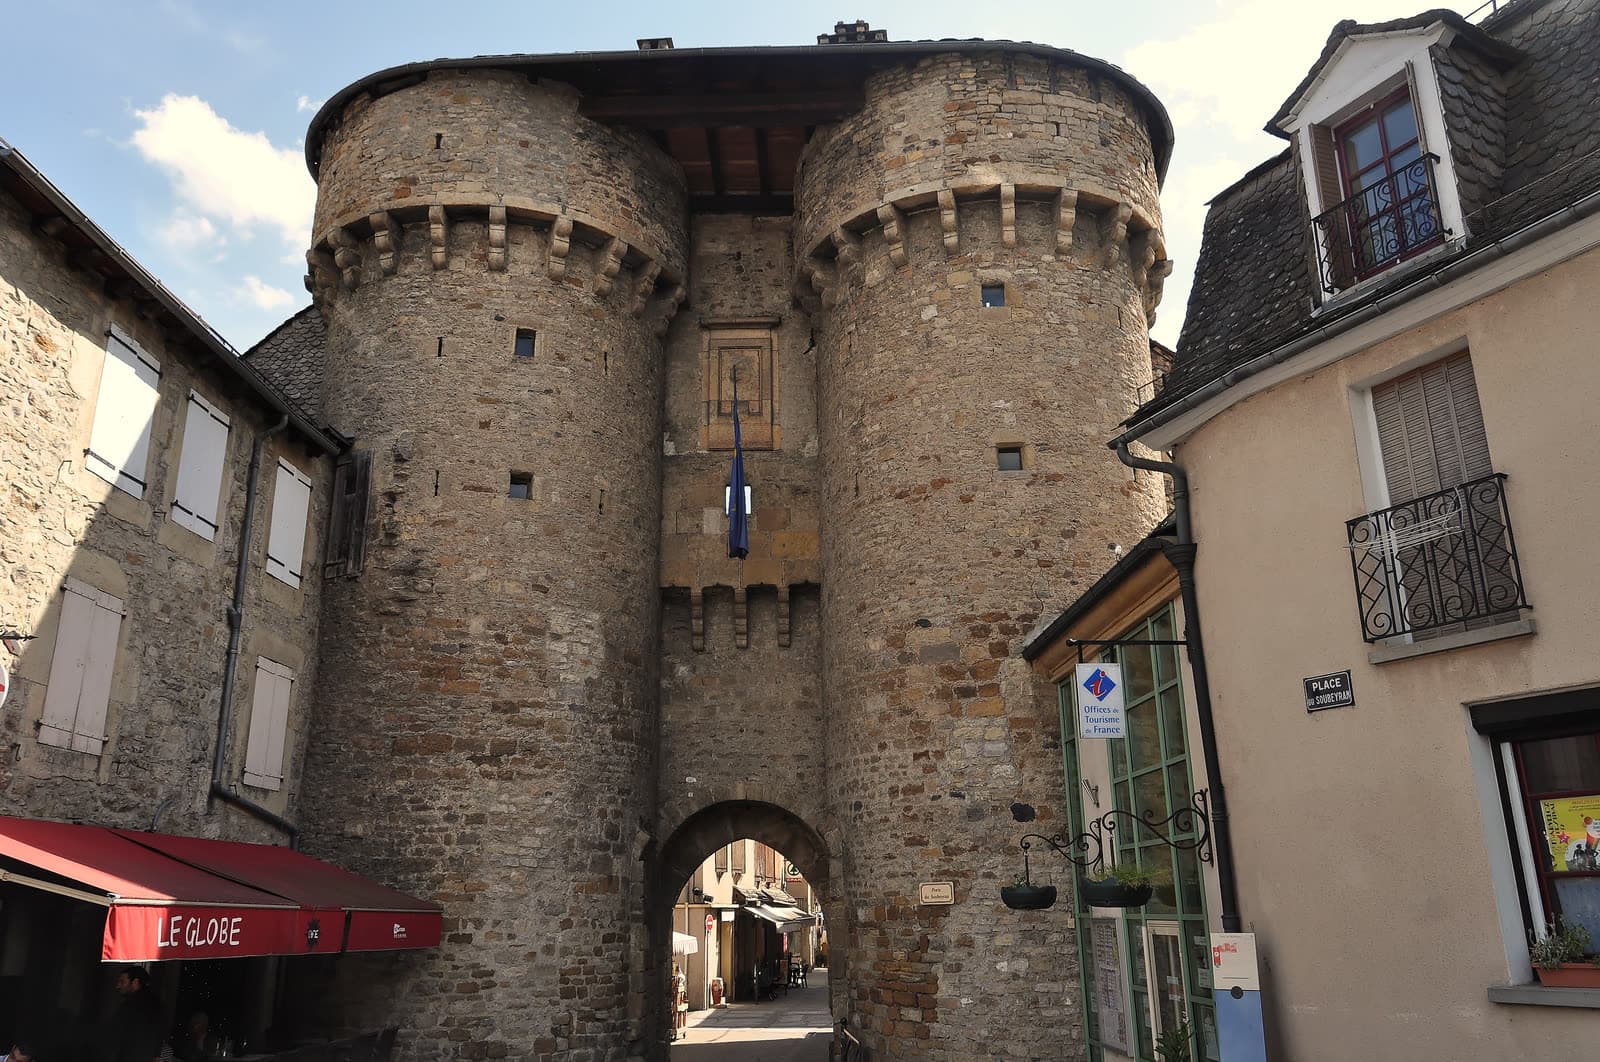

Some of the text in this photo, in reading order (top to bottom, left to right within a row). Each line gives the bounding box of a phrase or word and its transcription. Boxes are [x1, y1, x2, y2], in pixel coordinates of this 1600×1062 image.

[1312, 677, 1342, 692] PLACE
[1084, 705, 1111, 714] Offices
[1085, 715, 1121, 724] Tourisme
[1093, 725, 1121, 734] France
[157, 915, 243, 949] LE GLOBE
